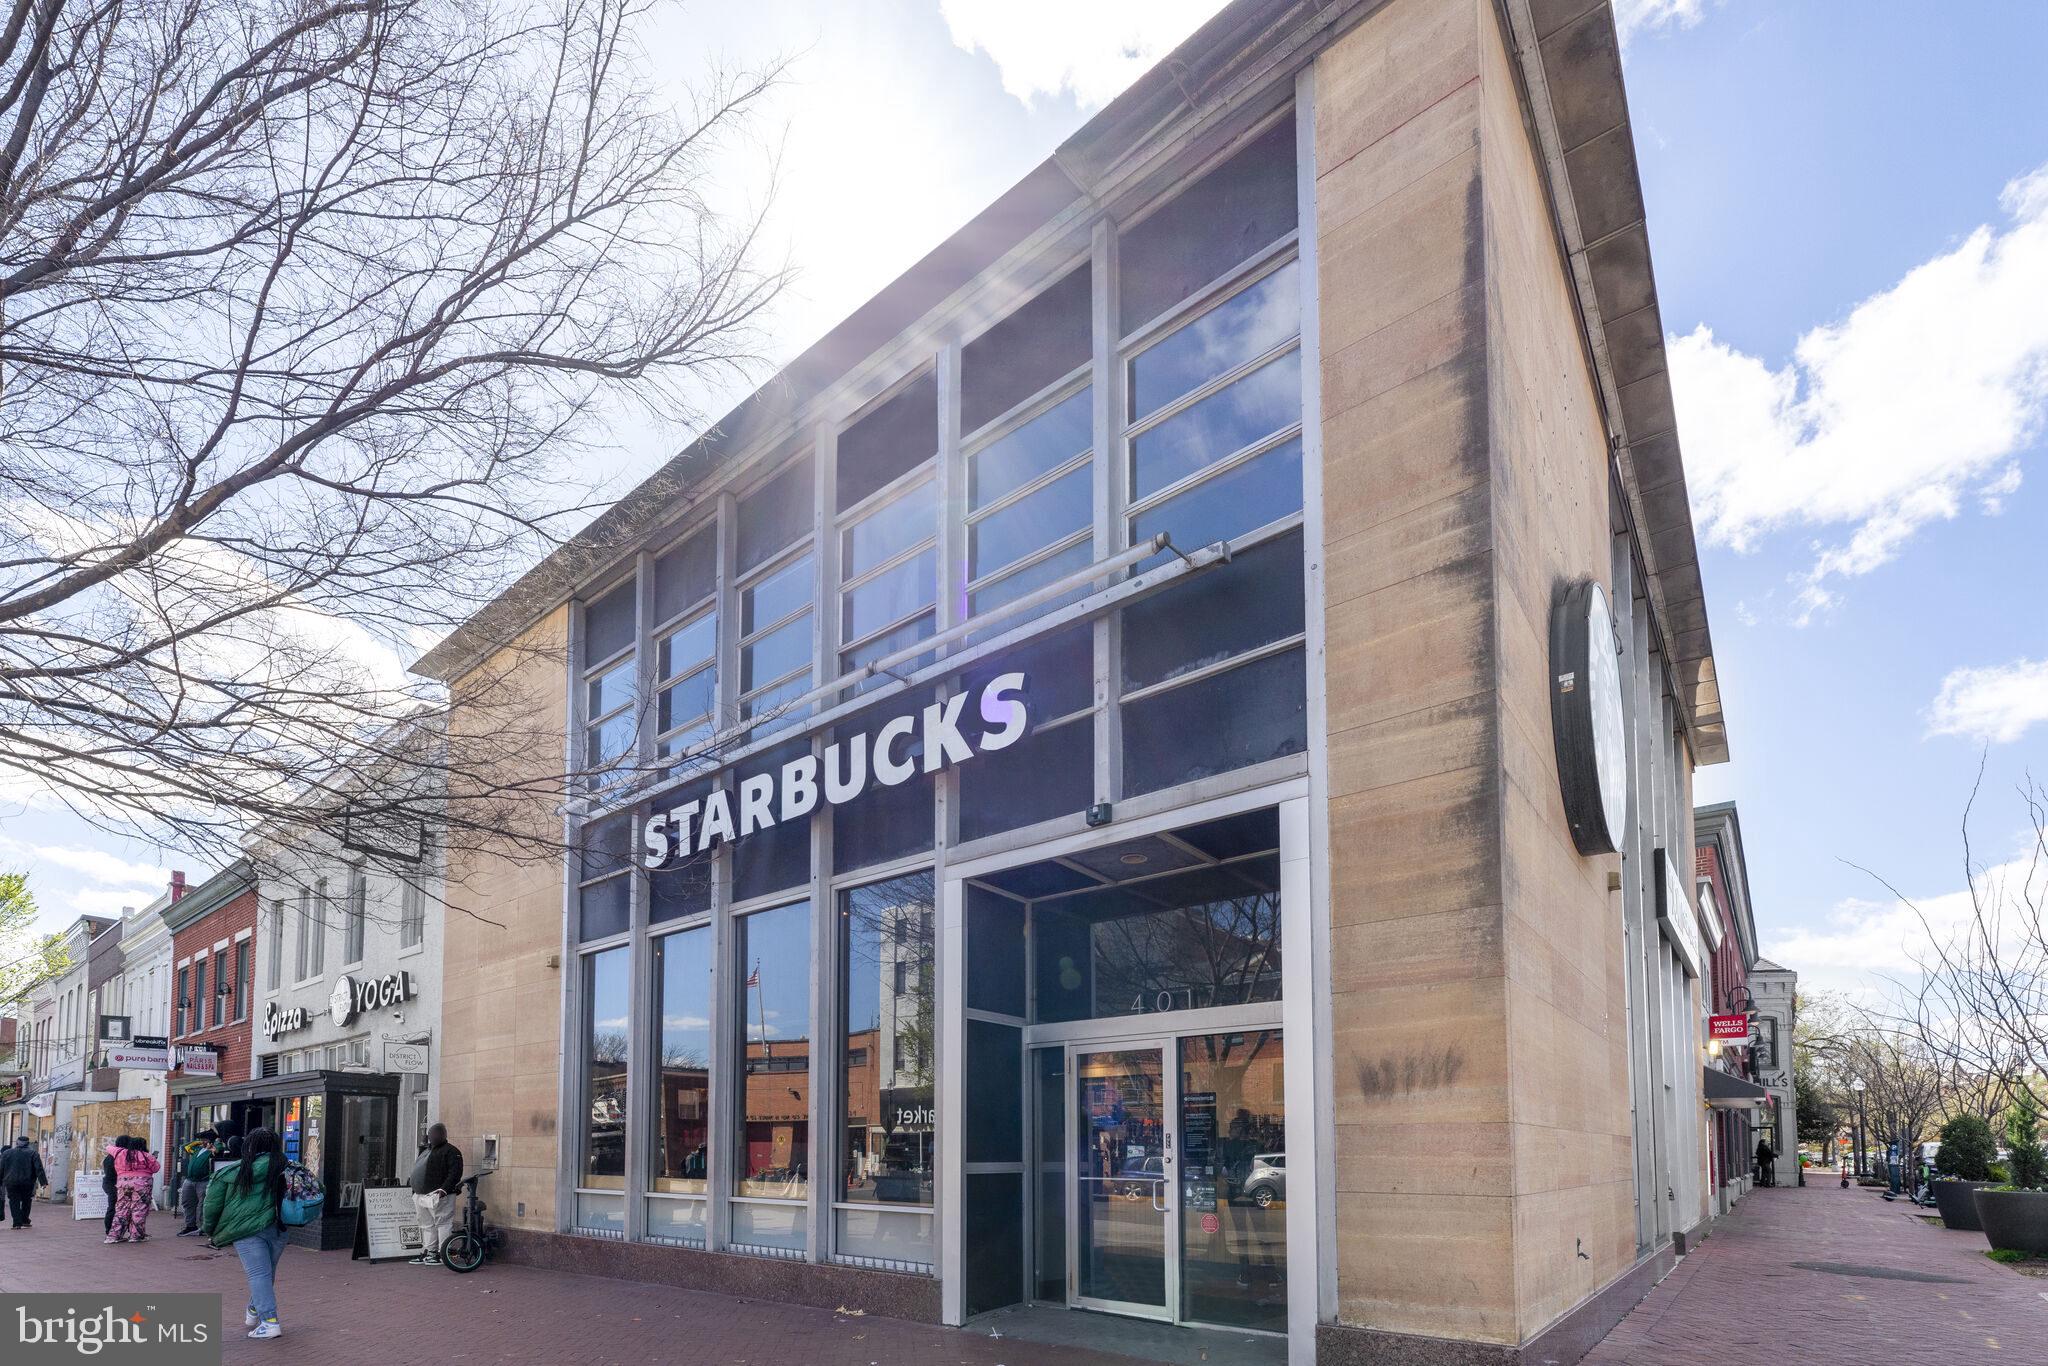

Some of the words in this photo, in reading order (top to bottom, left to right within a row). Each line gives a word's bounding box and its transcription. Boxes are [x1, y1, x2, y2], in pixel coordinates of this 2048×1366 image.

[644, 672, 1028, 868] STARBUCKS
[356, 971, 406, 1013] YOGA
[1131, 988, 1191, 1015] 401
[263, 1002, 301, 1042] &pizza
[1713, 1019, 1743, 1027] WELLS
[1714, 1026, 1744, 1034] FARGO
[389, 1052, 416, 1061] DISTRICT
[405, 1058, 424, 1066] FLOW
